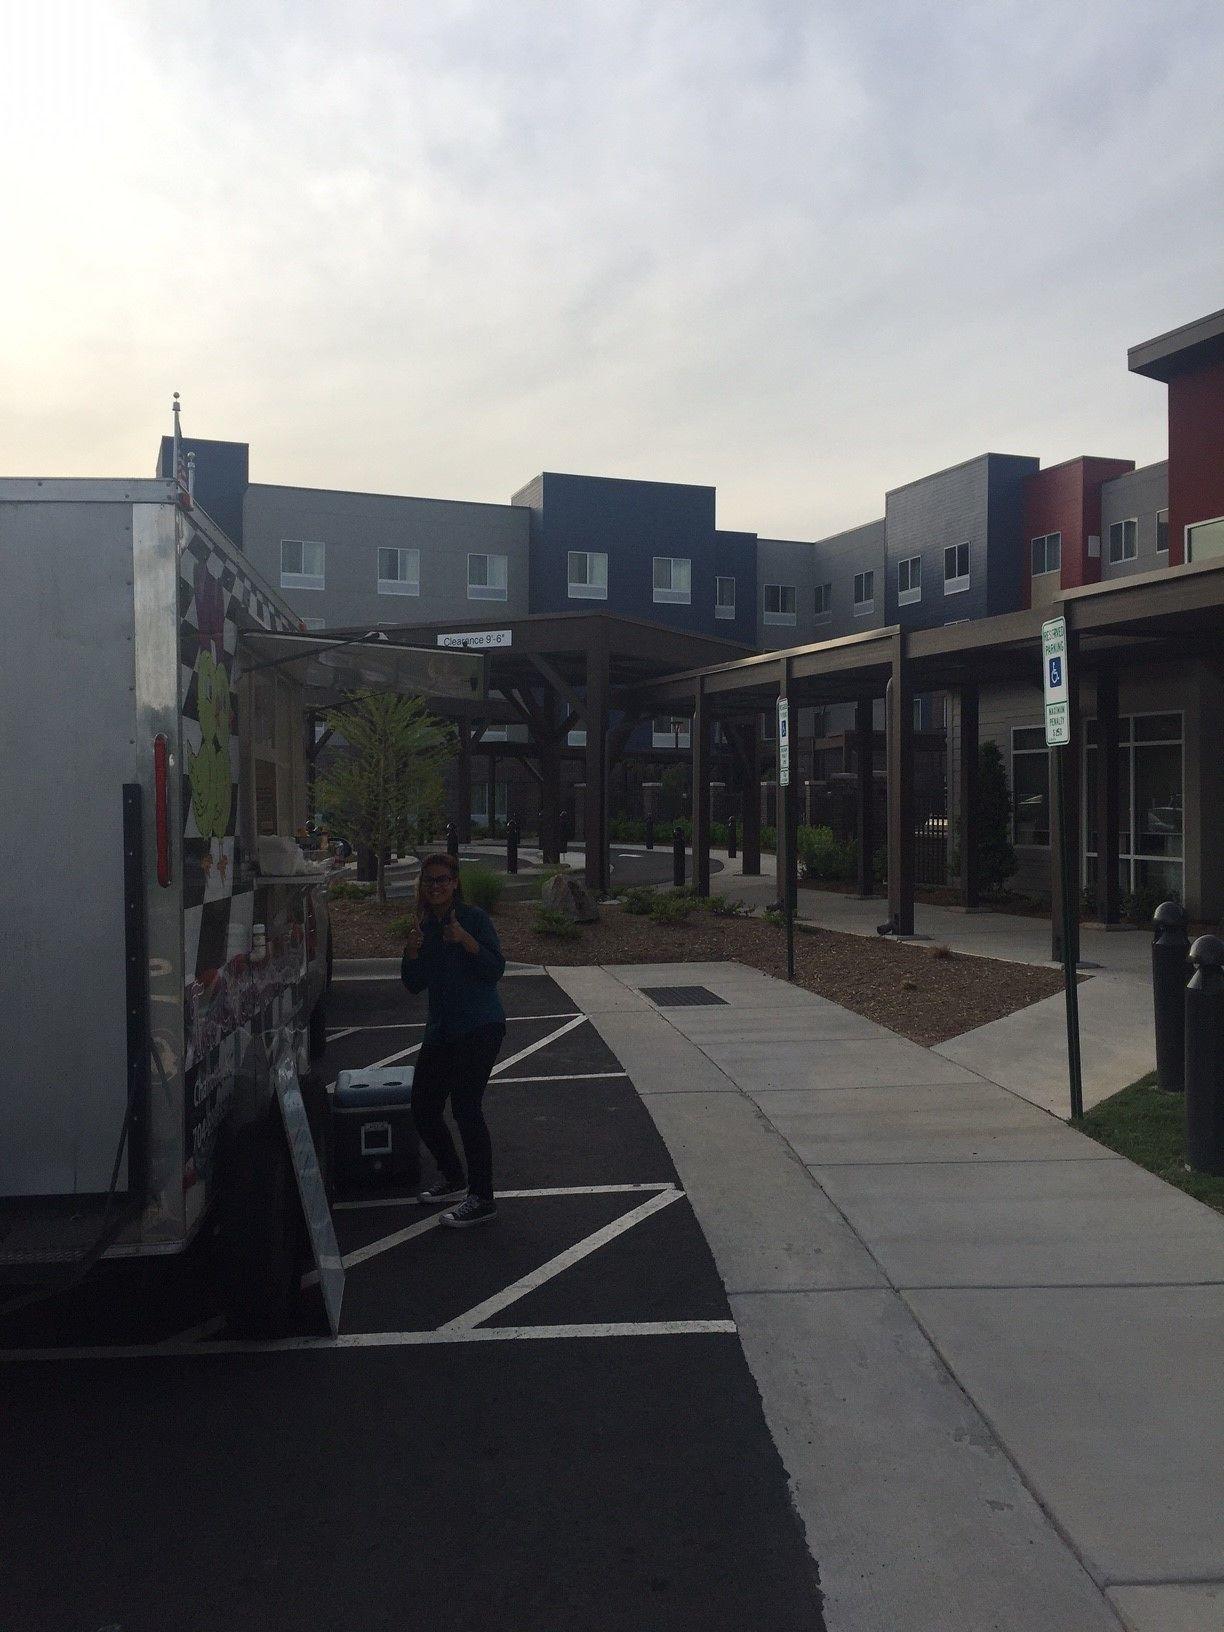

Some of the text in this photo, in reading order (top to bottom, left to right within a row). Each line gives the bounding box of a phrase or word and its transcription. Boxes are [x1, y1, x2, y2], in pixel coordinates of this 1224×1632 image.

[1043, 625, 1064, 641] RESERVED
[443, 636, 484, 647] Clearance
[1045, 641, 1064, 656] PARKING
